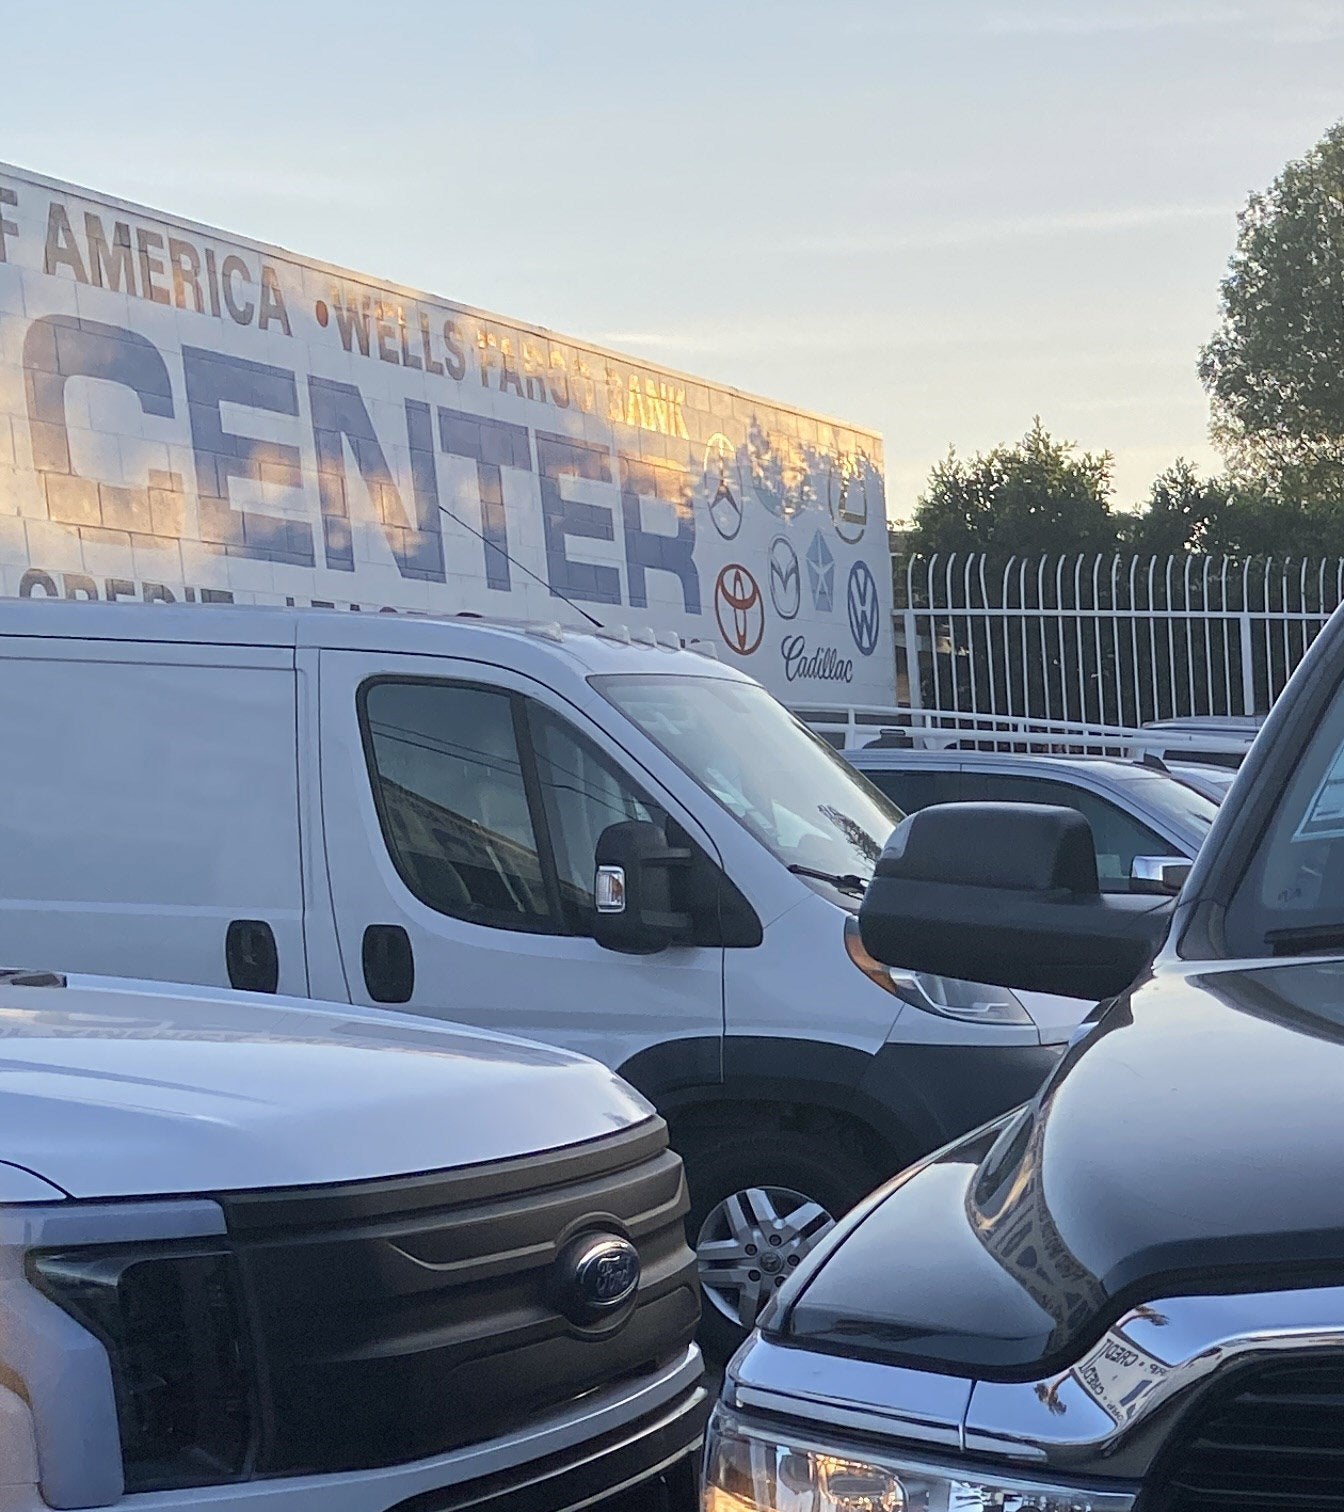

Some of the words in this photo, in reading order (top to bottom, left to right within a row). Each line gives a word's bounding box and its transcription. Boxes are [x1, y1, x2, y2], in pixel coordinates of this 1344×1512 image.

[43, 202, 293, 337] AMERICA
[332, 284, 466, 381] WELLS
[24, 313, 701, 615] CENTER
[780, 634, 854, 684] Cadillac
